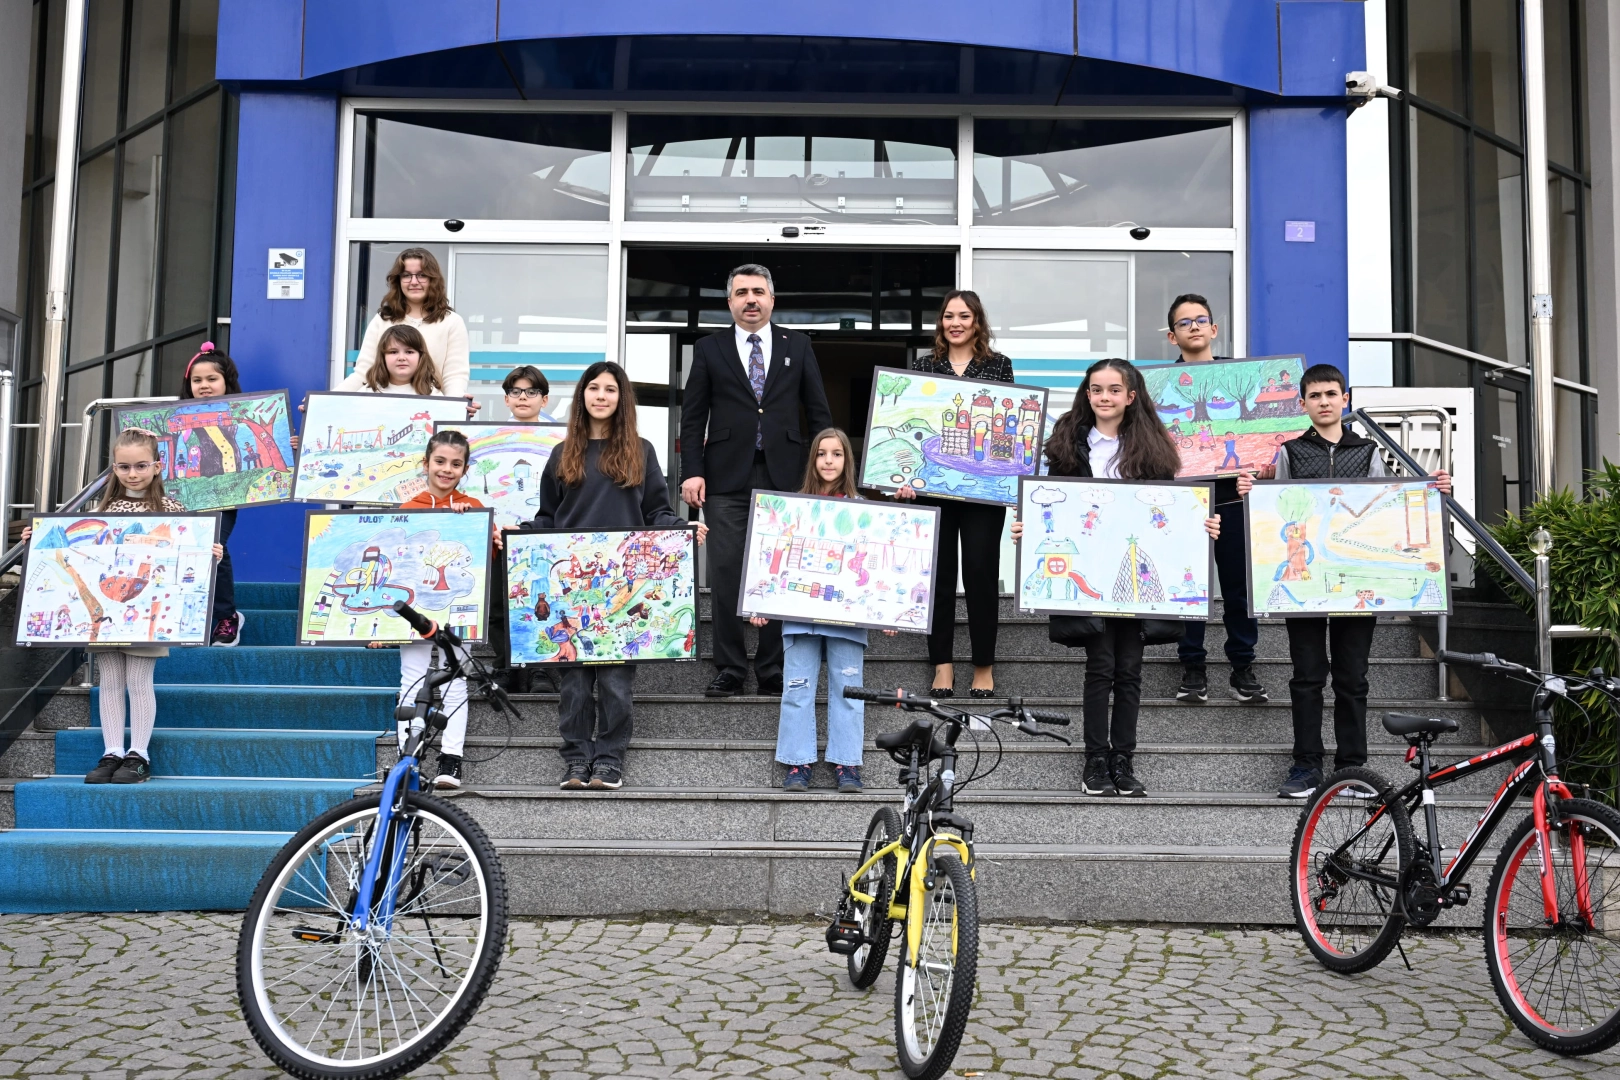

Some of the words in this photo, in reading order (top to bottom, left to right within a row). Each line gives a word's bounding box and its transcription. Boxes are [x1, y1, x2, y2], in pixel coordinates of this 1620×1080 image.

[1297, 227, 1303, 238] 2
[390, 514, 409, 523] PARK
[1480, 740, 1522, 761] SAFIR
